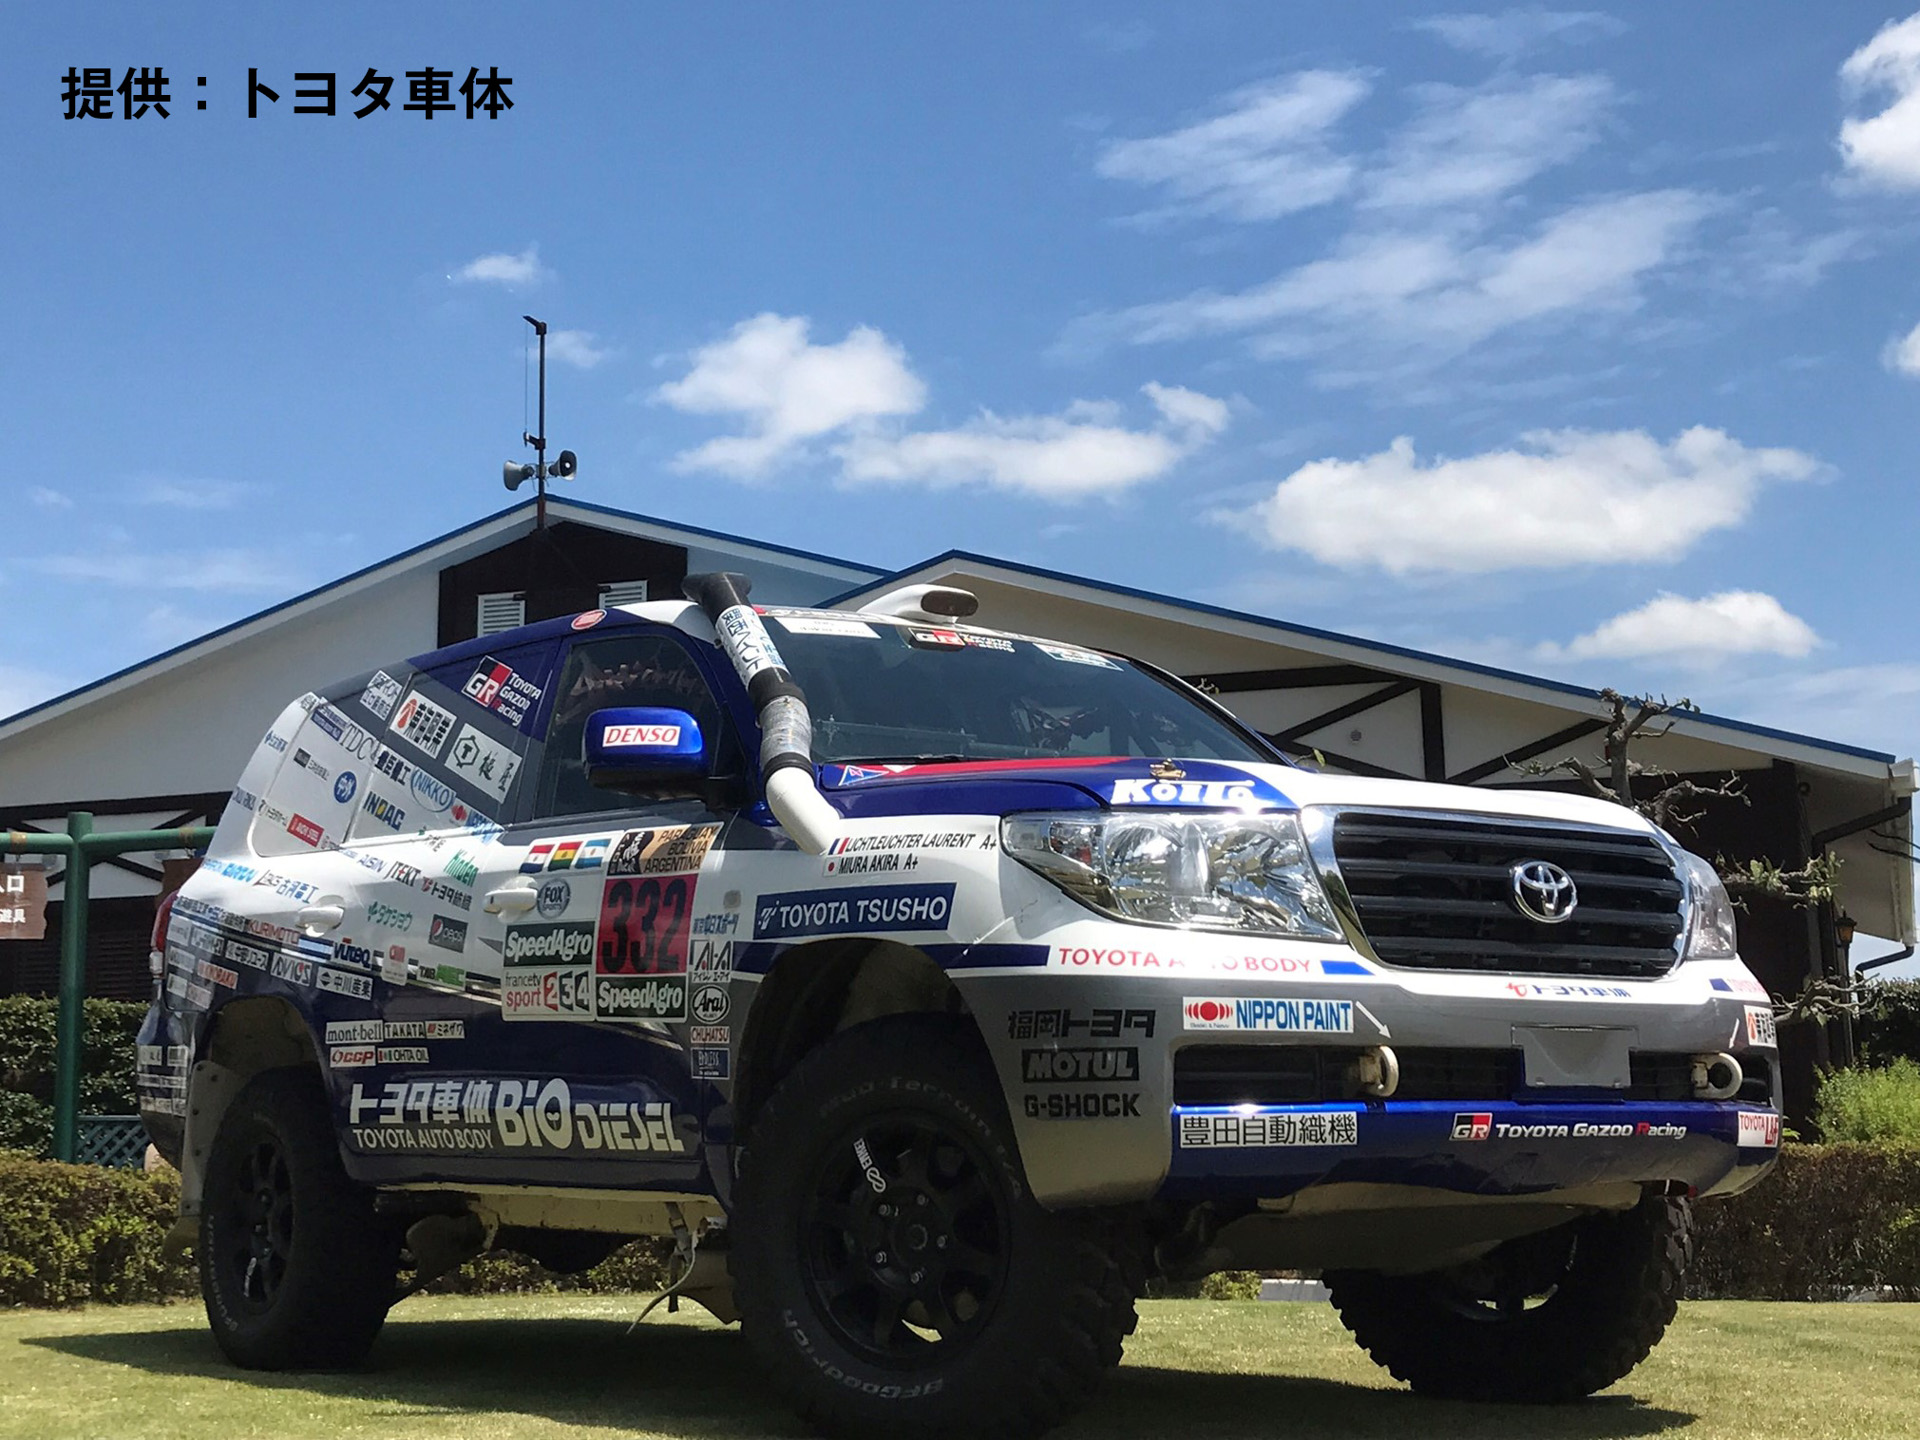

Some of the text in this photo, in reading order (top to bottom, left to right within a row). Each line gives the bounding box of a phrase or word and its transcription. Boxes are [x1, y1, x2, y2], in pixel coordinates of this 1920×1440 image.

[466, 673, 499, 705] GR
[499, 688, 531, 710] GAZOO
[508, 673, 543, 701] TOYOTA
[492, 698, 523, 727] Racing
[606, 728, 678, 744] DENSO
[658, 826, 719, 843] PARAGUAY
[922, 833, 977, 851] LAURENT
[980, 834, 997, 852] A+
[668, 840, 709, 856] BOLIVIA
[384, 861, 421, 887] JTEKT
[644, 856, 703, 873] ARGENTINA
[839, 852, 919, 874] MIURA AKIRA A+
[0, 875, 25, 892] 口
[543, 886, 565, 905] FOX
[779, 896, 948, 929] TOYOTA TSUSHO
[602, 879, 688, 973] 332
[507, 930, 592, 962] SpeedAgro
[1059, 948, 1158, 968] TOYOTA
[1246, 956, 1311, 978] BODY
[334, 972, 373, 998] 中川産業
[507, 989, 542, 1012] sport
[599, 982, 683, 1014] SpeedAgro
[697, 992, 727, 1014] Arai
[1008, 1008, 1156, 1039] 福岡トヨタ
[1236, 1000, 1351, 1031] NIPPON PAINT
[386, 1023, 425, 1038] TAKATA
[692, 1029, 729, 1042] CHUHATSU
[1026, 1050, 1135, 1080] MOTUL
[350, 1080, 493, 1125] トヨタ車体
[1024, 1092, 1140, 1118] G-SHOCK
[1181, 1114, 1356, 1146] 豊田自動織機
[1454, 1121, 1688, 1140] GR TOYOTA GAZOO Racing
[1739, 1113, 1765, 1131] TOYOTA
[353, 1129, 494, 1150] TOYOTA AUTO BODY
